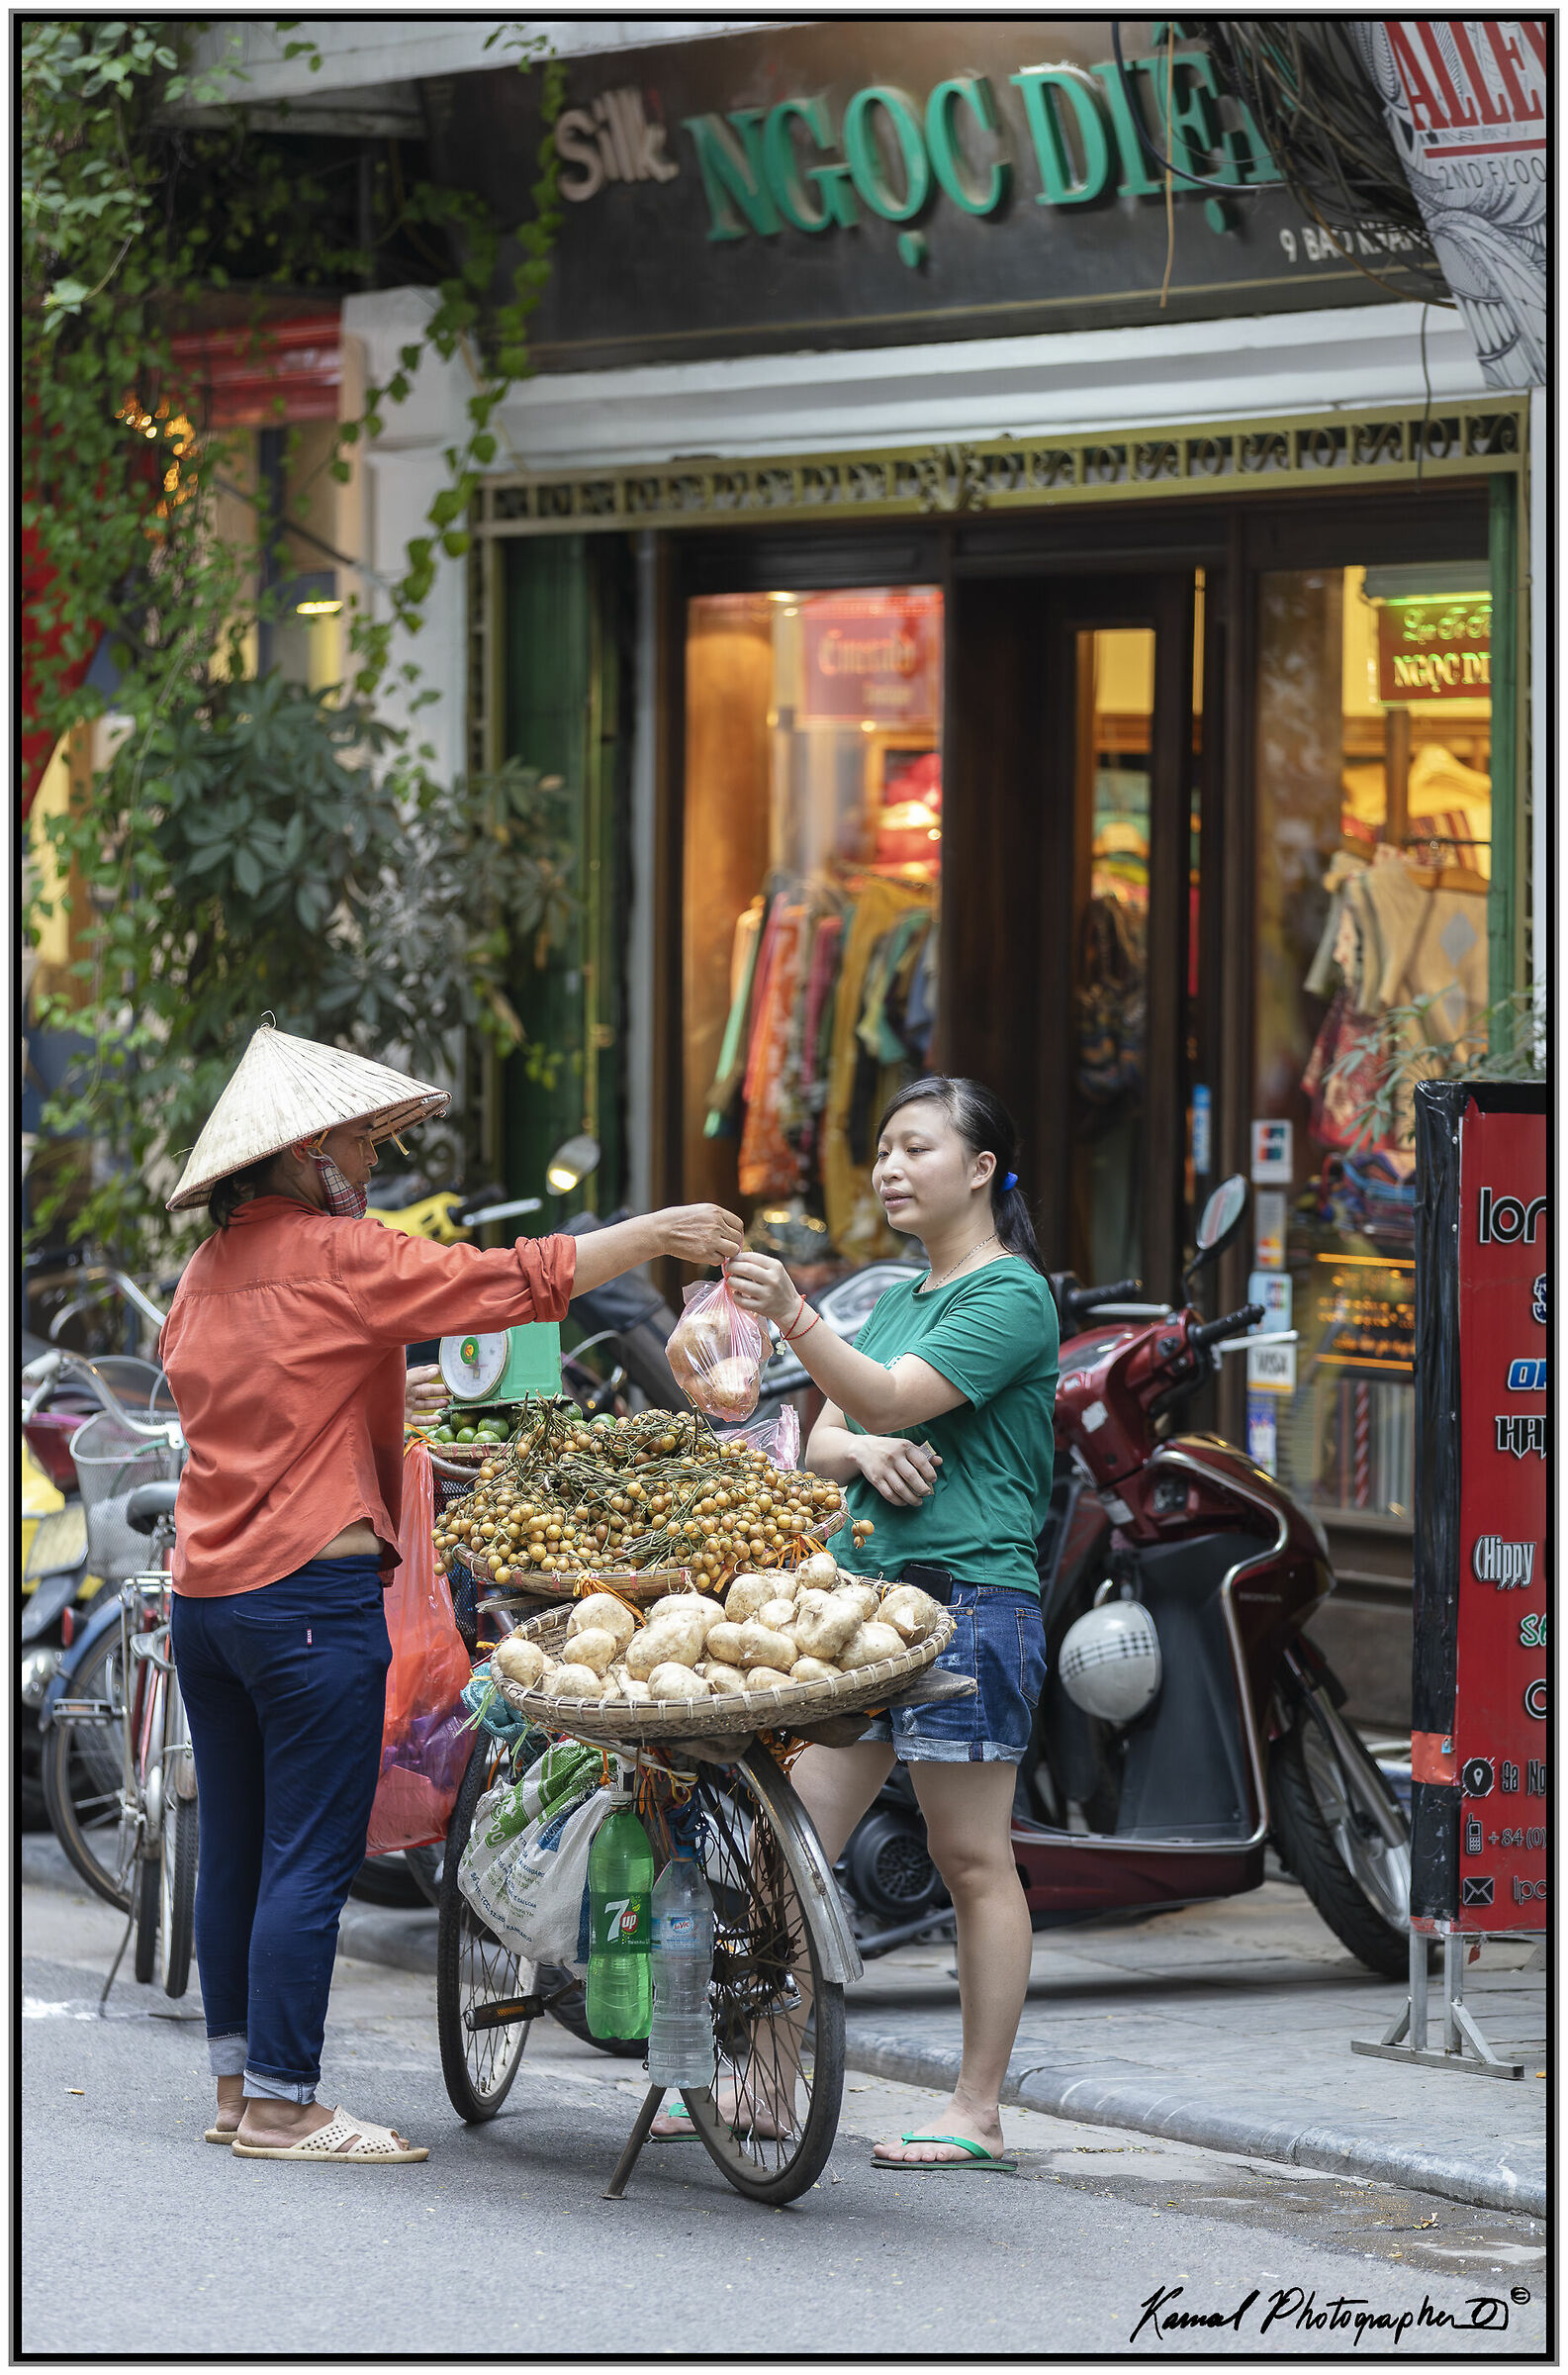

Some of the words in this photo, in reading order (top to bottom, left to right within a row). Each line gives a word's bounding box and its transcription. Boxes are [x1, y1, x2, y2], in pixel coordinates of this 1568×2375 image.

[555, 86, 680, 203] Silk
[680, 71, 1012, 268] NGỌC
[1438, 162, 1484, 190] 2ND
[1279, 228, 1297, 263] 9
